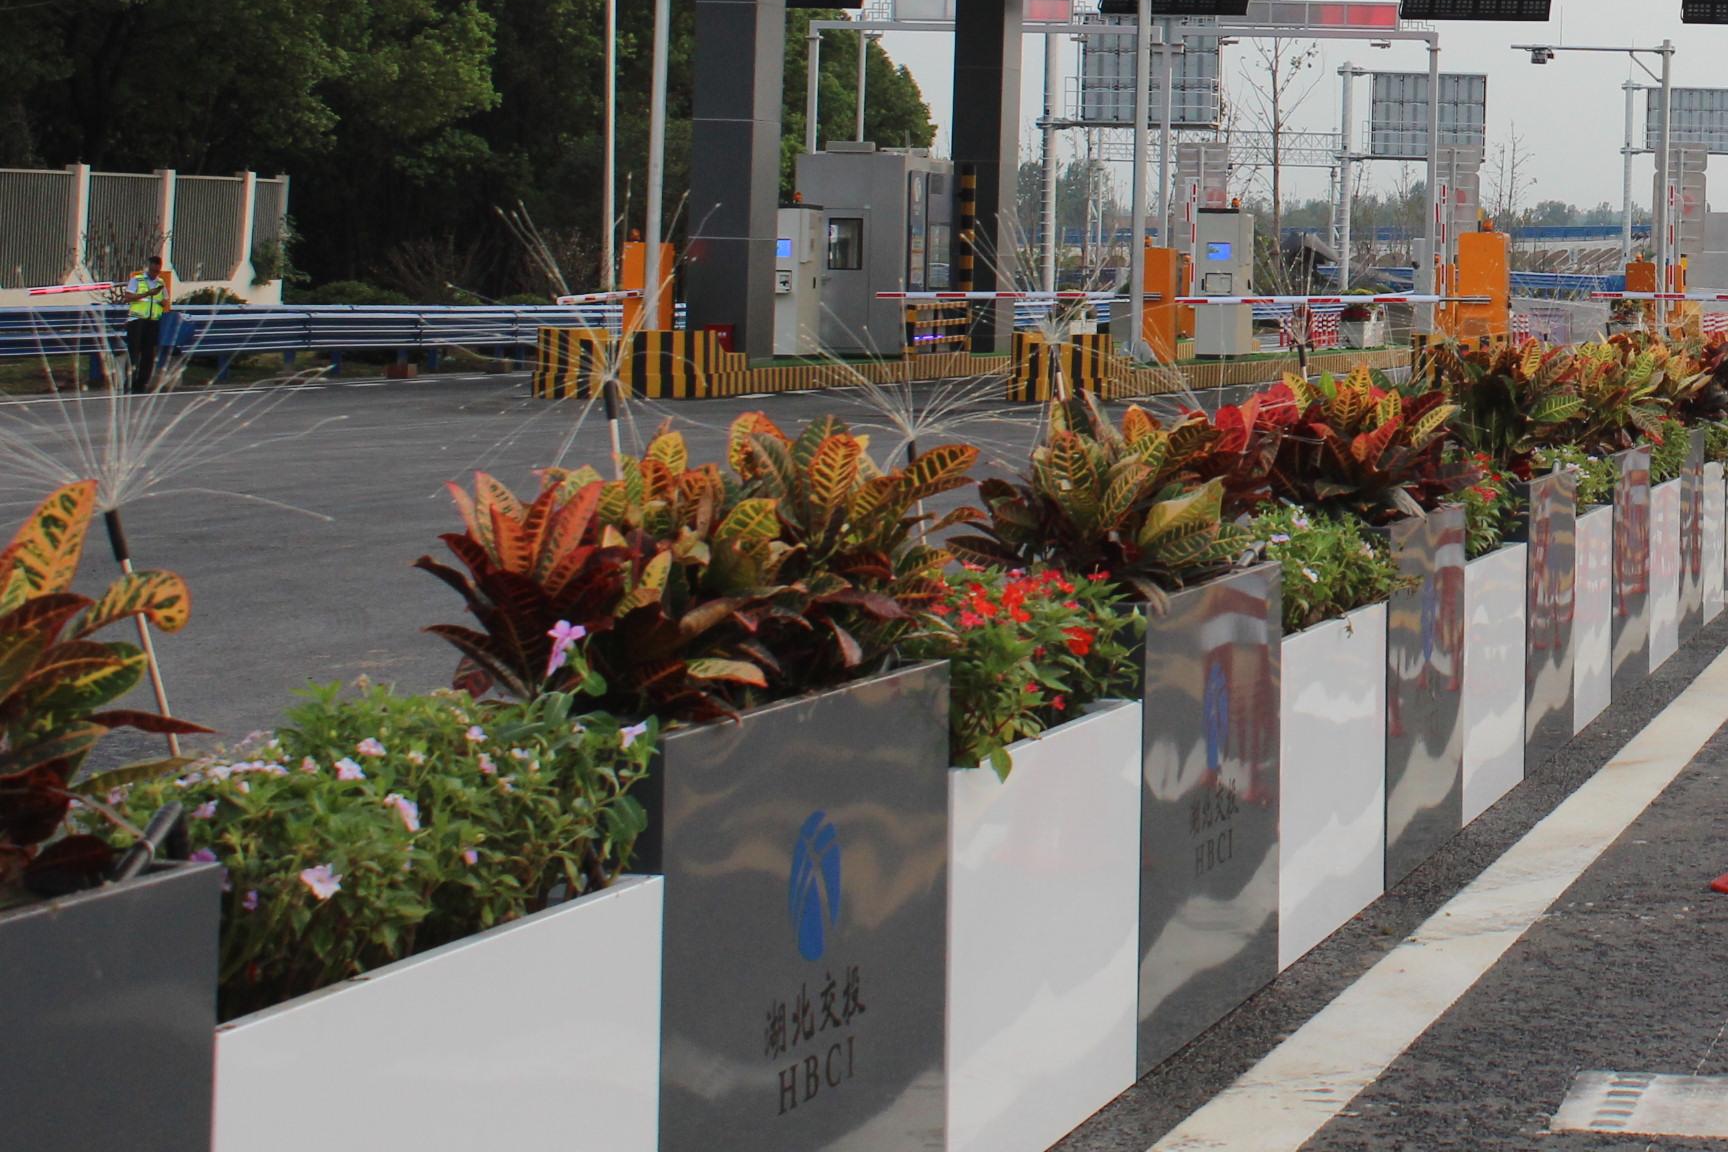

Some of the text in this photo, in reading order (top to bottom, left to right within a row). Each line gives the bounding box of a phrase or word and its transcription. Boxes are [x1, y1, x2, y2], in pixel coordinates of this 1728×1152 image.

[764, 965, 866, 1061] 湖北交投
[777, 1035, 856, 1117] HBCI
